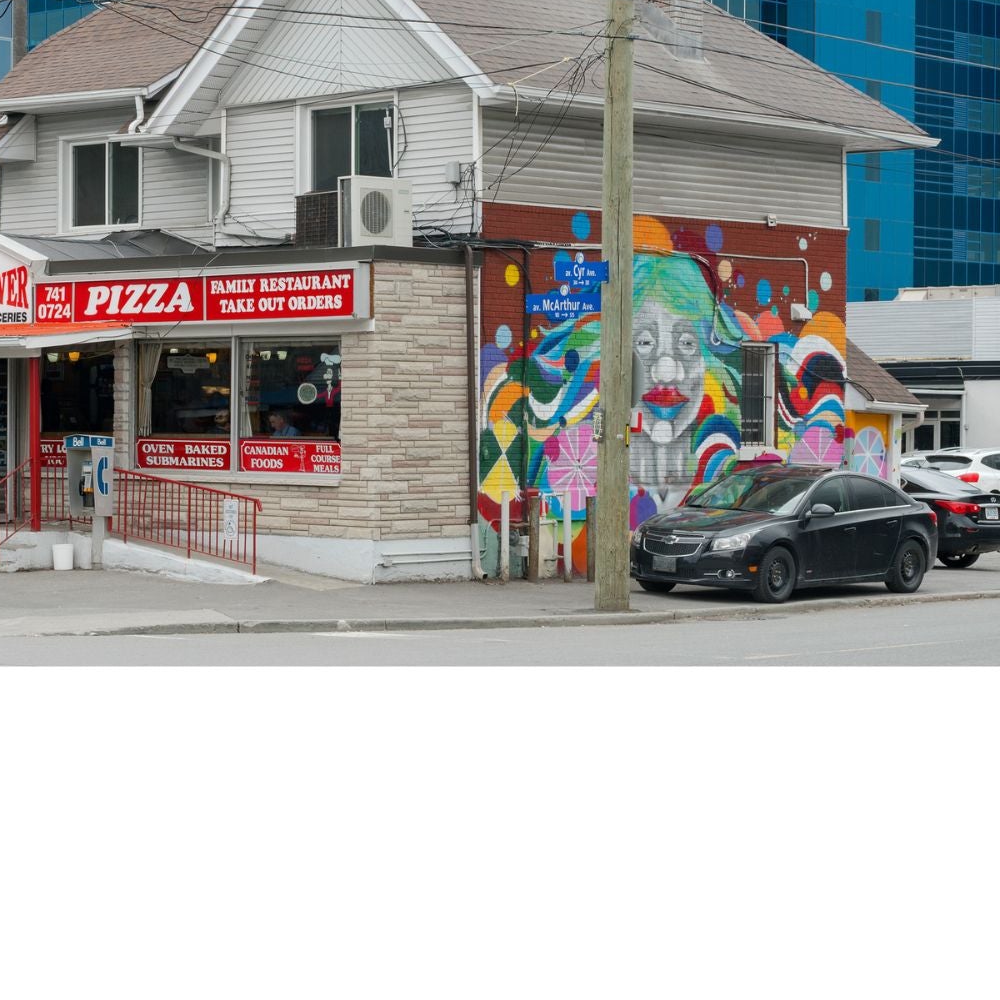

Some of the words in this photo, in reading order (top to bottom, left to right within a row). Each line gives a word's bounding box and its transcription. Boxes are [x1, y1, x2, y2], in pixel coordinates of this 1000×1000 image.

[573, 264, 585, 280] Cyr
[210, 278, 256, 295] FAMILY
[259, 273, 351, 293] RESTAURANT
[44, 286, 66, 301] 741
[83, 281, 195, 316] PIZZA
[219, 298, 255, 314] TAKE
[258, 296, 285, 312] OUT
[288, 294, 343, 311] ORDERS
[542, 298, 580, 311] McArthur
[37, 303, 71, 319] 0724
[72, 437, 84, 447] Bell
[142, 443, 174, 454] OVEN
[184, 444, 227, 455] BAKED
[244, 445, 289, 456] CANADIAN
[315, 444, 334, 454] FULL
[146, 455, 224, 467] SUBMARINES
[250, 458, 284, 469] FOODS
[310, 455, 341, 464] COURSE
[313, 464, 340, 473] MEALS
